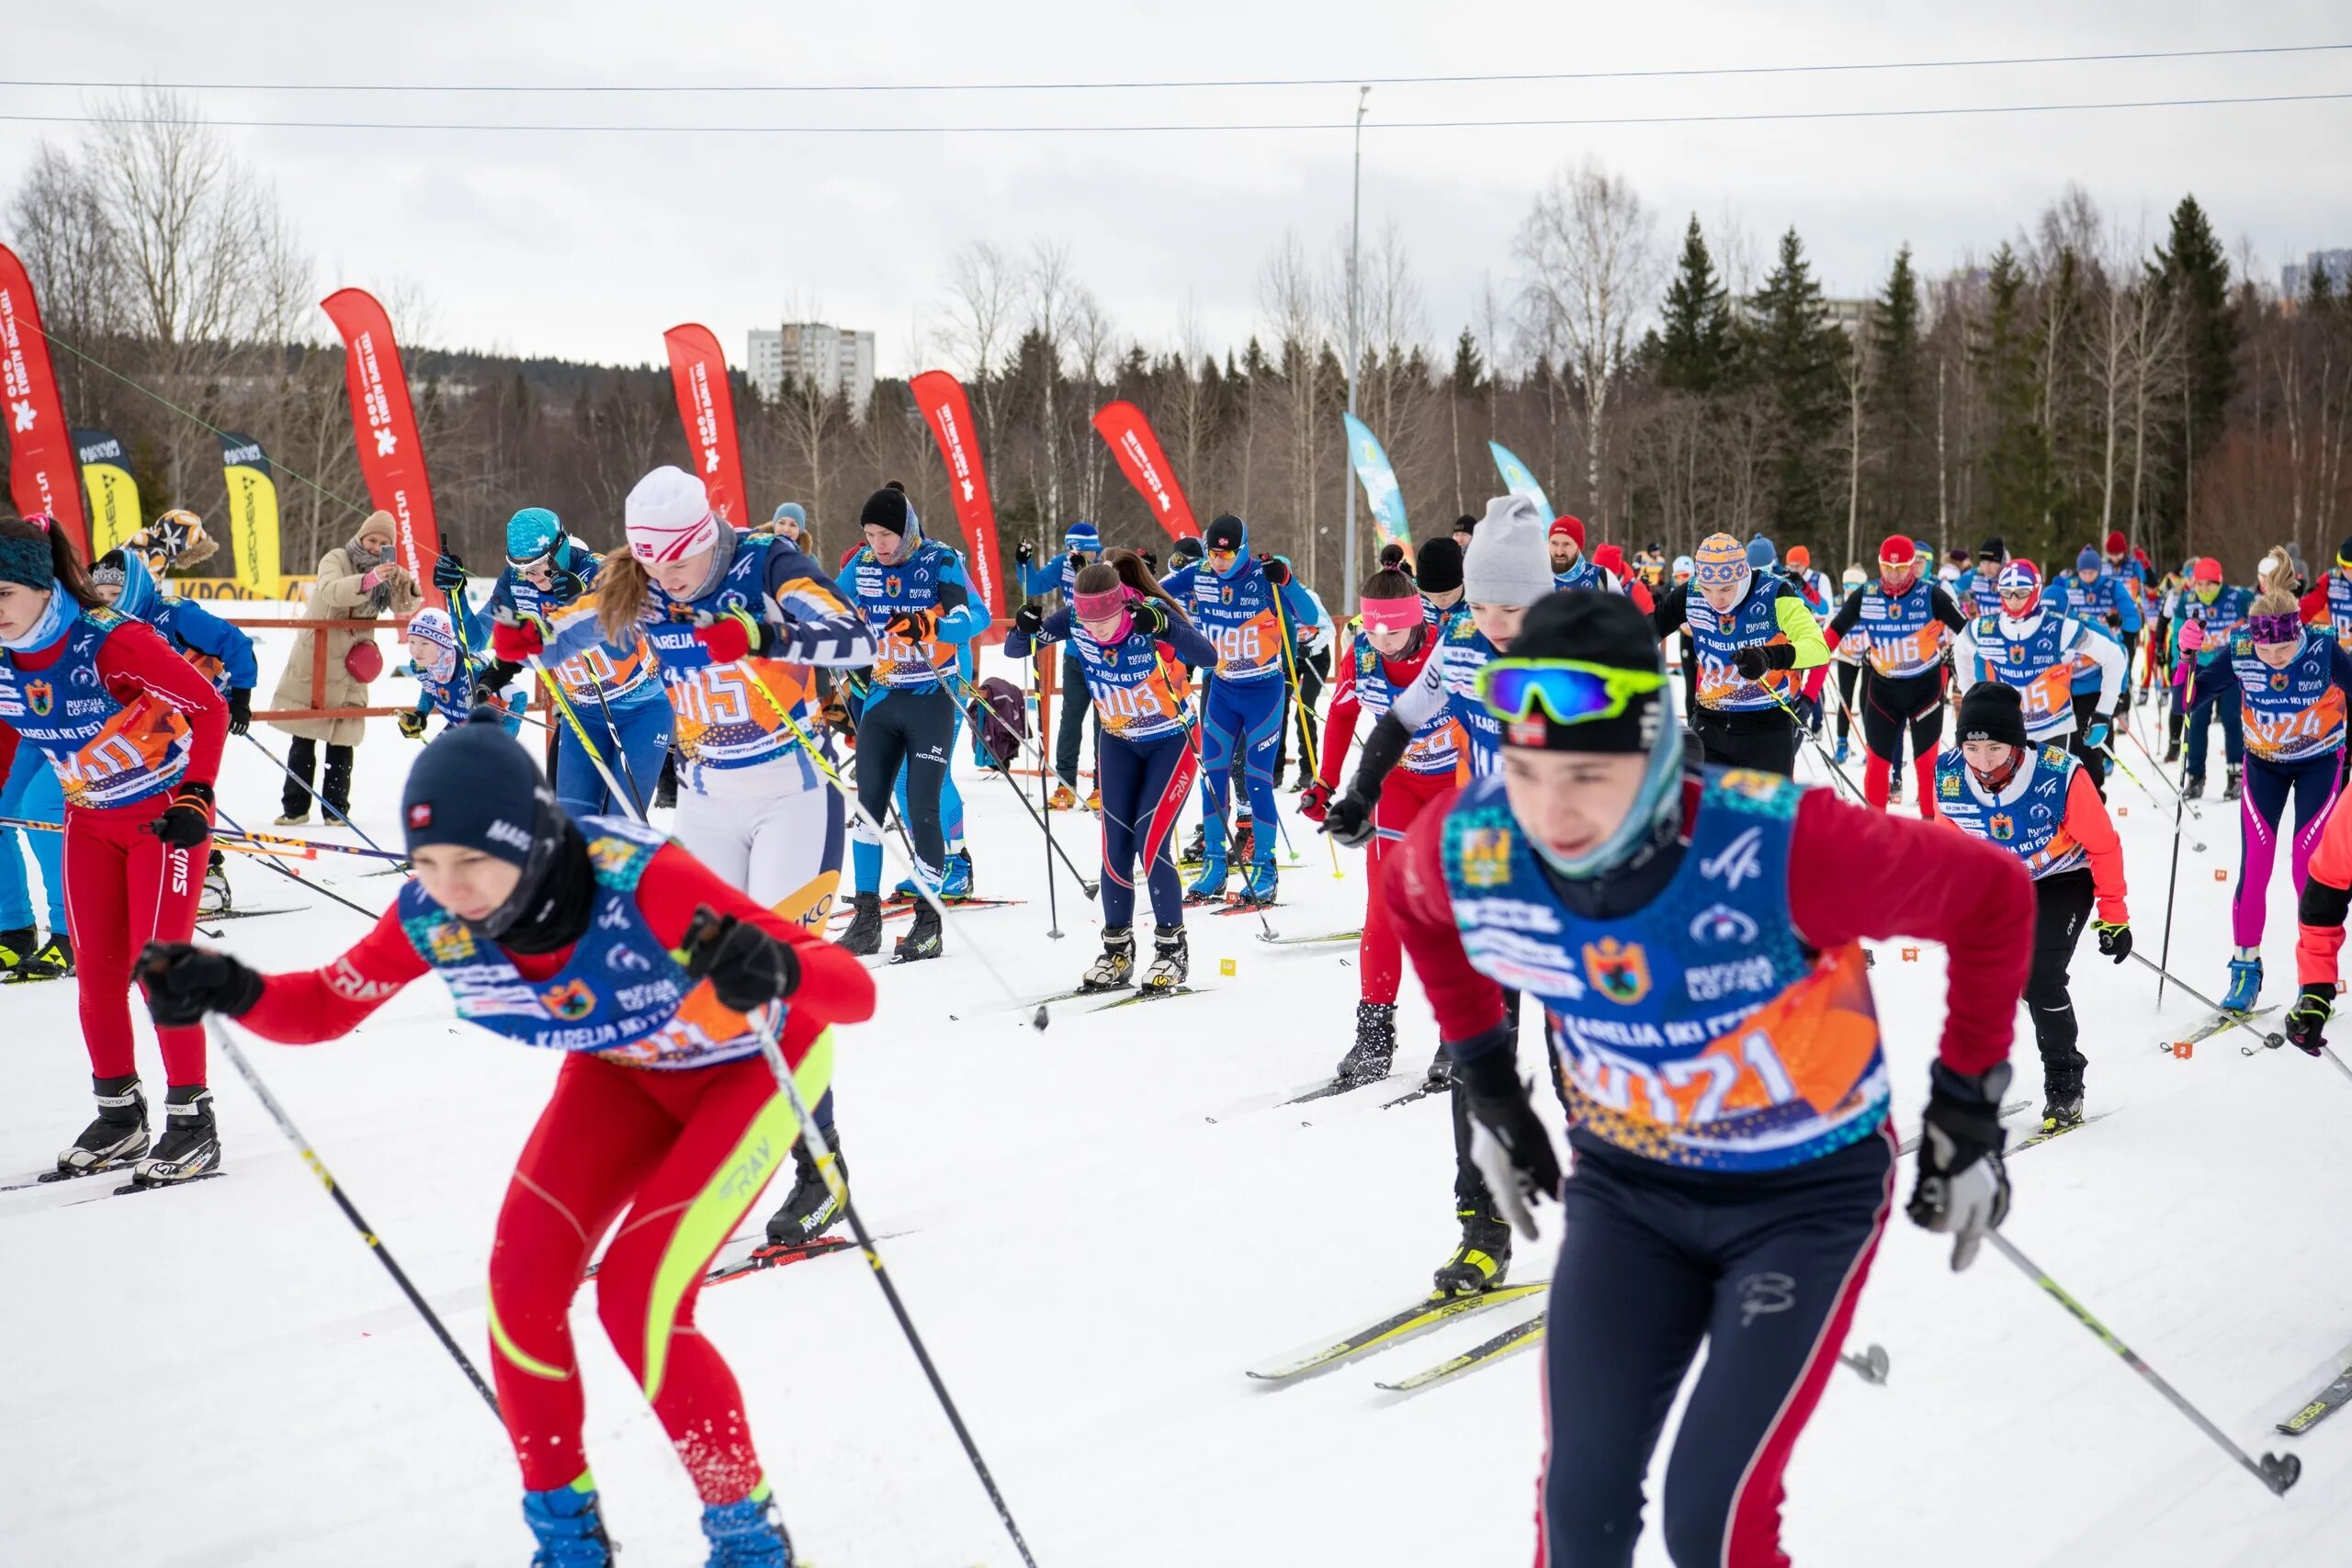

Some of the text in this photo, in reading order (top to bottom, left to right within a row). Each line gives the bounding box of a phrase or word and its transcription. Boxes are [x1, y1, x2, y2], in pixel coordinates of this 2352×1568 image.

[1707, 637, 1736, 651] KARELIA
[1748, 637, 1768, 649] FEST
[1133, 670, 1151, 682] FEST
[65, 698, 106, 710] RUSSIA
[1433, 715, 1453, 728] FEST
[2018, 840, 2034, 853] SKI
[1905, 950, 1916, 959] 10
[534, 1023, 618, 1050] KARELIA
[2179, 1045, 2187, 1055] 2
[801, 1194, 837, 1234] NORDWA
[1440, 1296, 1485, 1318] FISCHER
